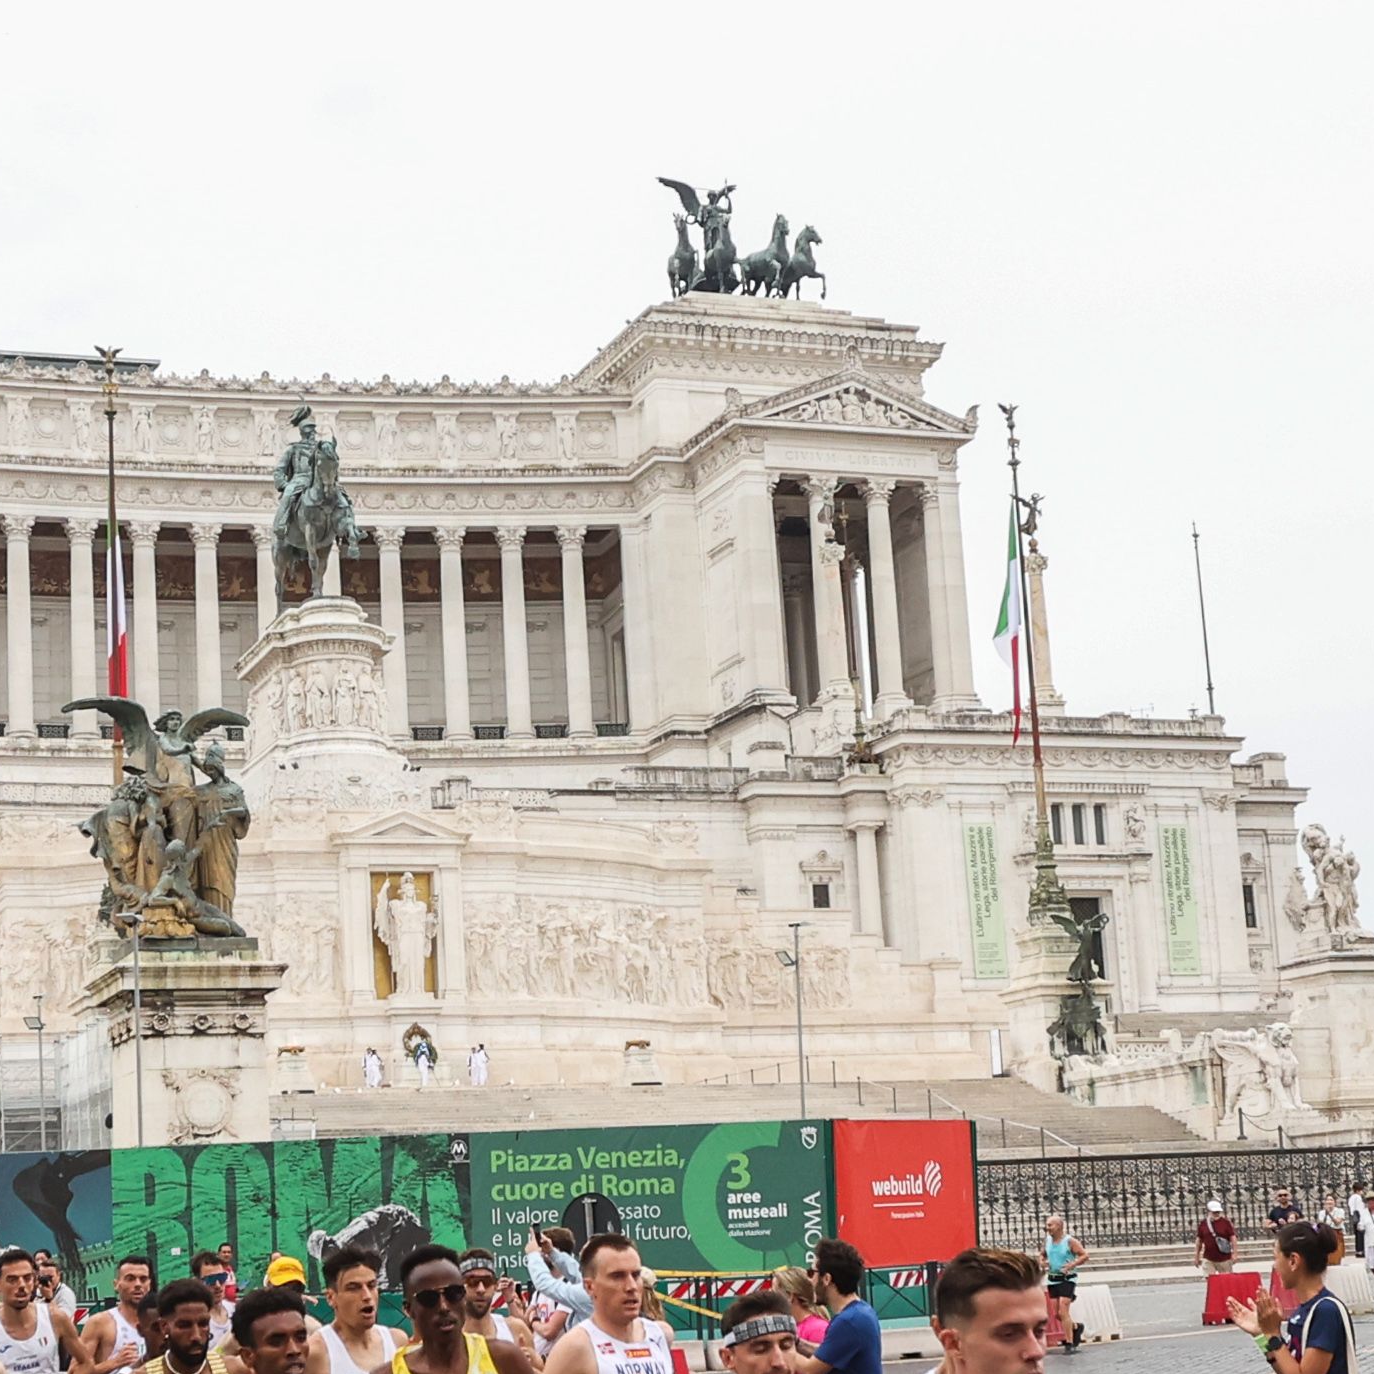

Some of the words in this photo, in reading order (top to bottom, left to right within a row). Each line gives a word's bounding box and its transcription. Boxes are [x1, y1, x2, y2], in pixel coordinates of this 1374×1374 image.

[849, 454, 917, 468] LIBERTATI
[970, 834, 978, 868] Mazzini
[977, 826, 988, 864] parallele
[986, 826, 998, 886] Risorgimento
[1164, 835, 1172, 868] Mazzini
[1180, 828, 1190, 887] Risorgimento
[490, 1149, 573, 1173] Piazza
[577, 1143, 686, 1170] Venezia,
[726, 1152, 752, 1191] 3
[490, 1181, 564, 1202] cuore
[570, 1174, 595, 1197] di
[601, 1174, 675, 1197] Roma
[727, 1192, 762, 1204] aree
[871, 1173, 923, 1196] webuild
[111, 1135, 468, 1292] ROMA
[492, 1208, 501, 1225] Il
[506, 1206, 559, 1225] valore
[619, 1204, 661, 1220] ssato
[728, 1203, 788, 1220] museali
[492, 1235, 503, 1247] e
[508, 1228, 522, 1247] la
[636, 1224, 692, 1241] futuro,
[494, 1252, 528, 1269] insie
